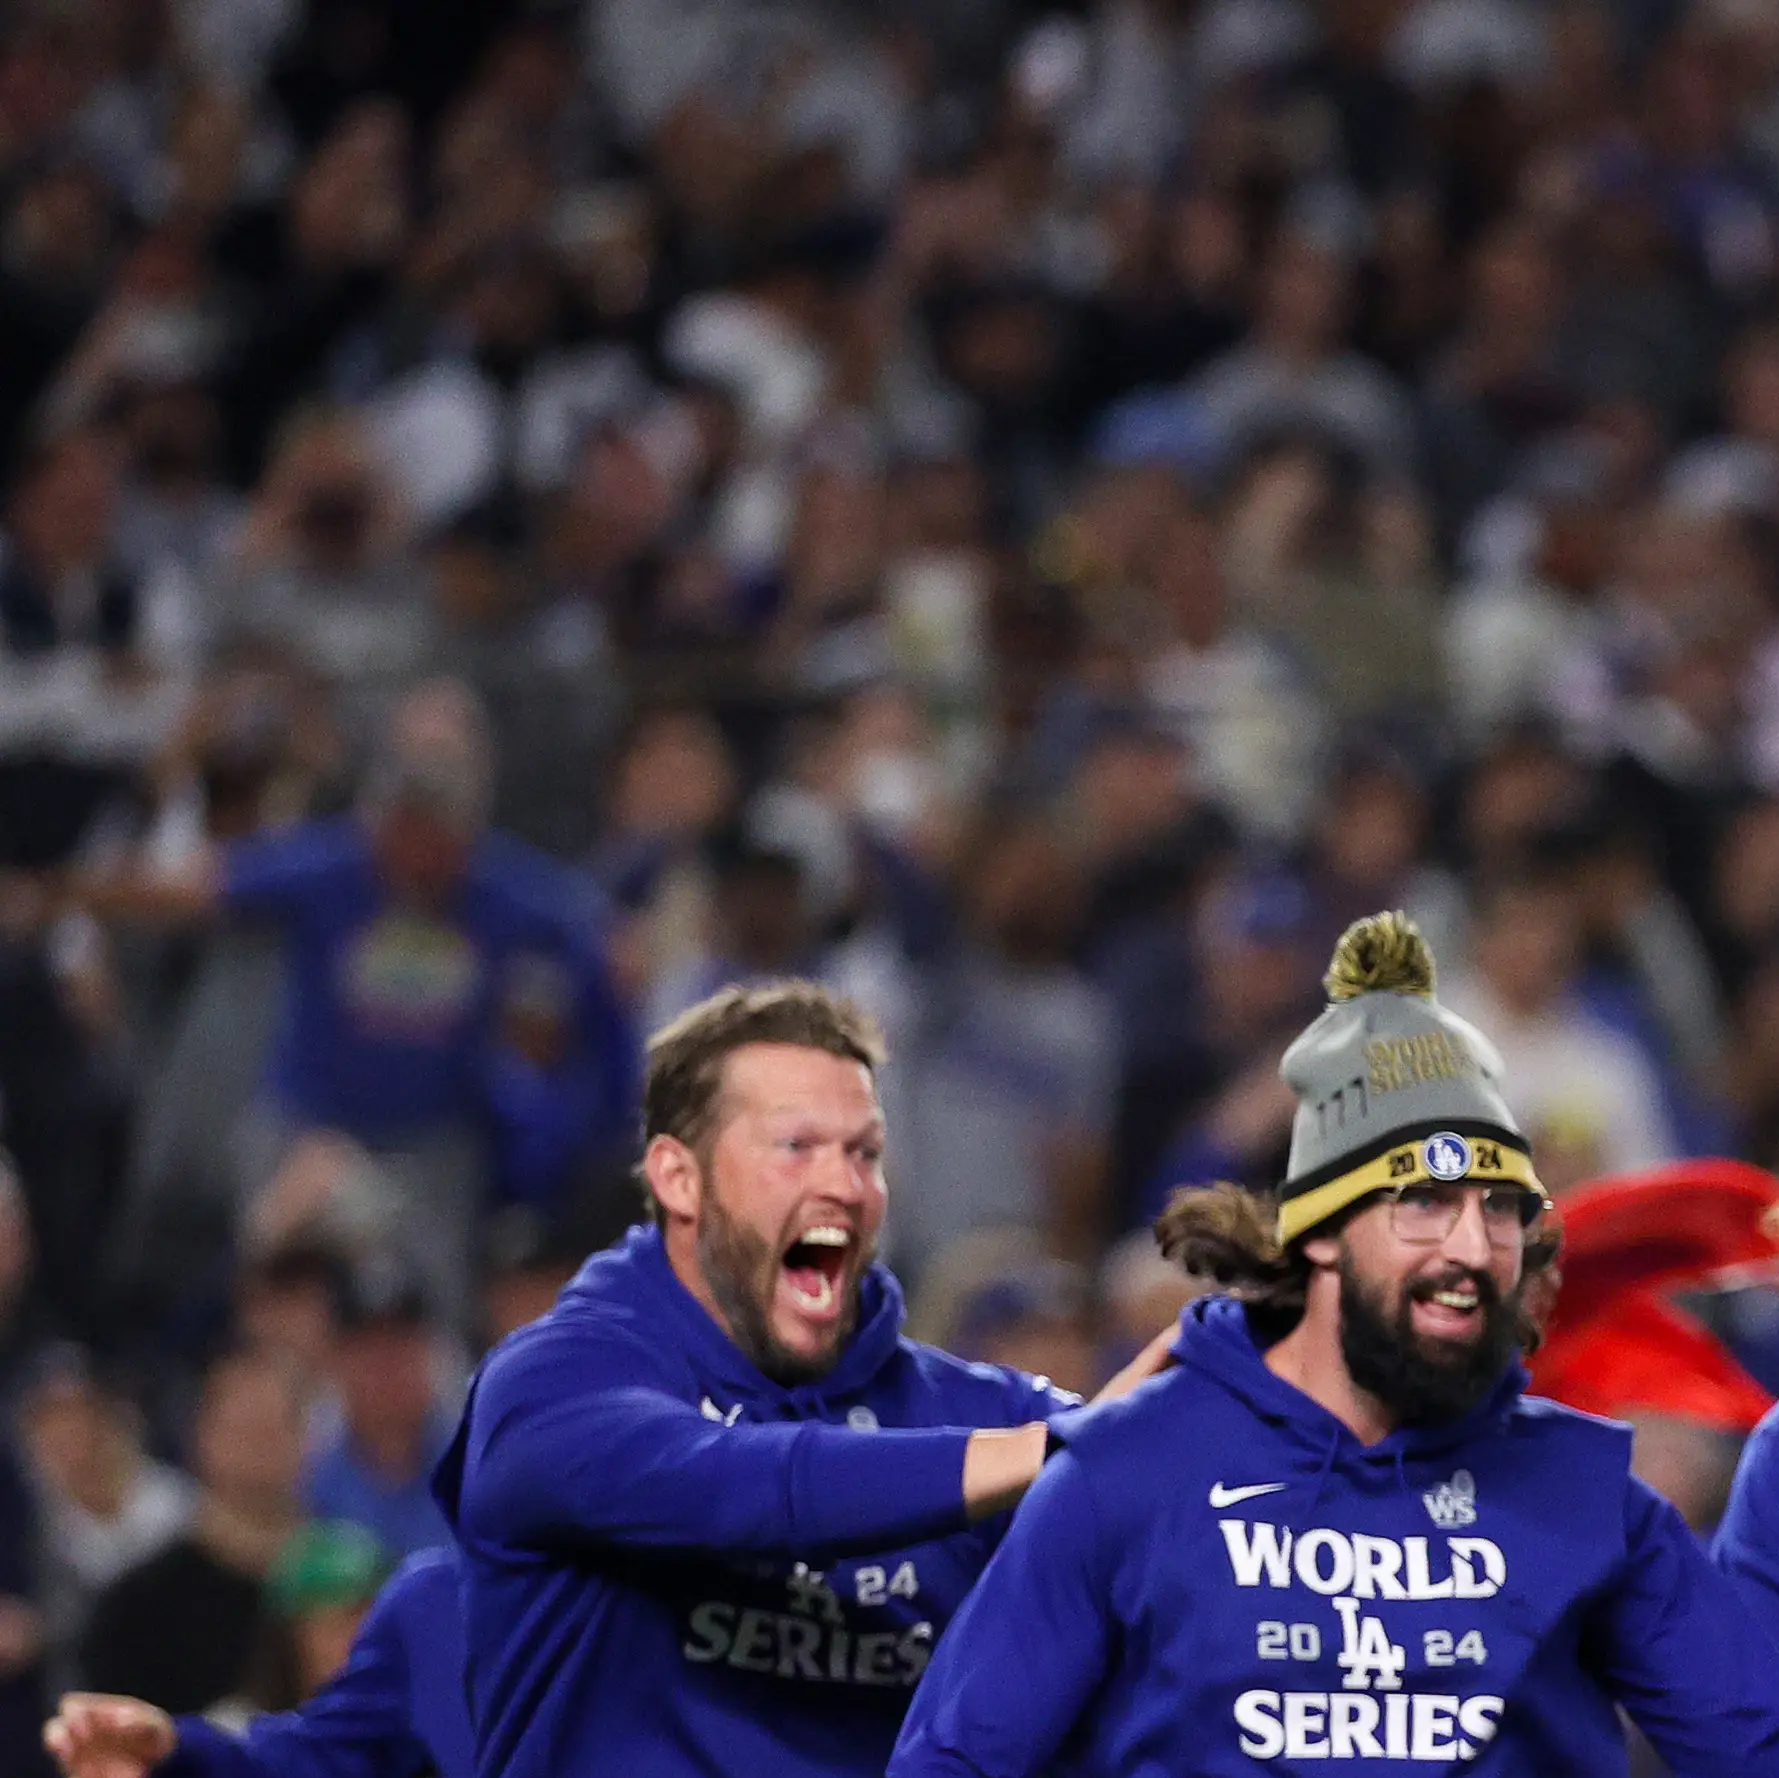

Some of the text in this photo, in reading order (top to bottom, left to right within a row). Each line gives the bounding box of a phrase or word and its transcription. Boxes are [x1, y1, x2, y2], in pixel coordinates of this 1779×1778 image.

[854, 1560, 919, 1607] 24
[1218, 1518, 1507, 1601] WORLD
[683, 1601, 935, 1688] SERIES
[1256, 1596, 1488, 1690] 20 LA 24
[1233, 1689, 1505, 1761] SERIES
